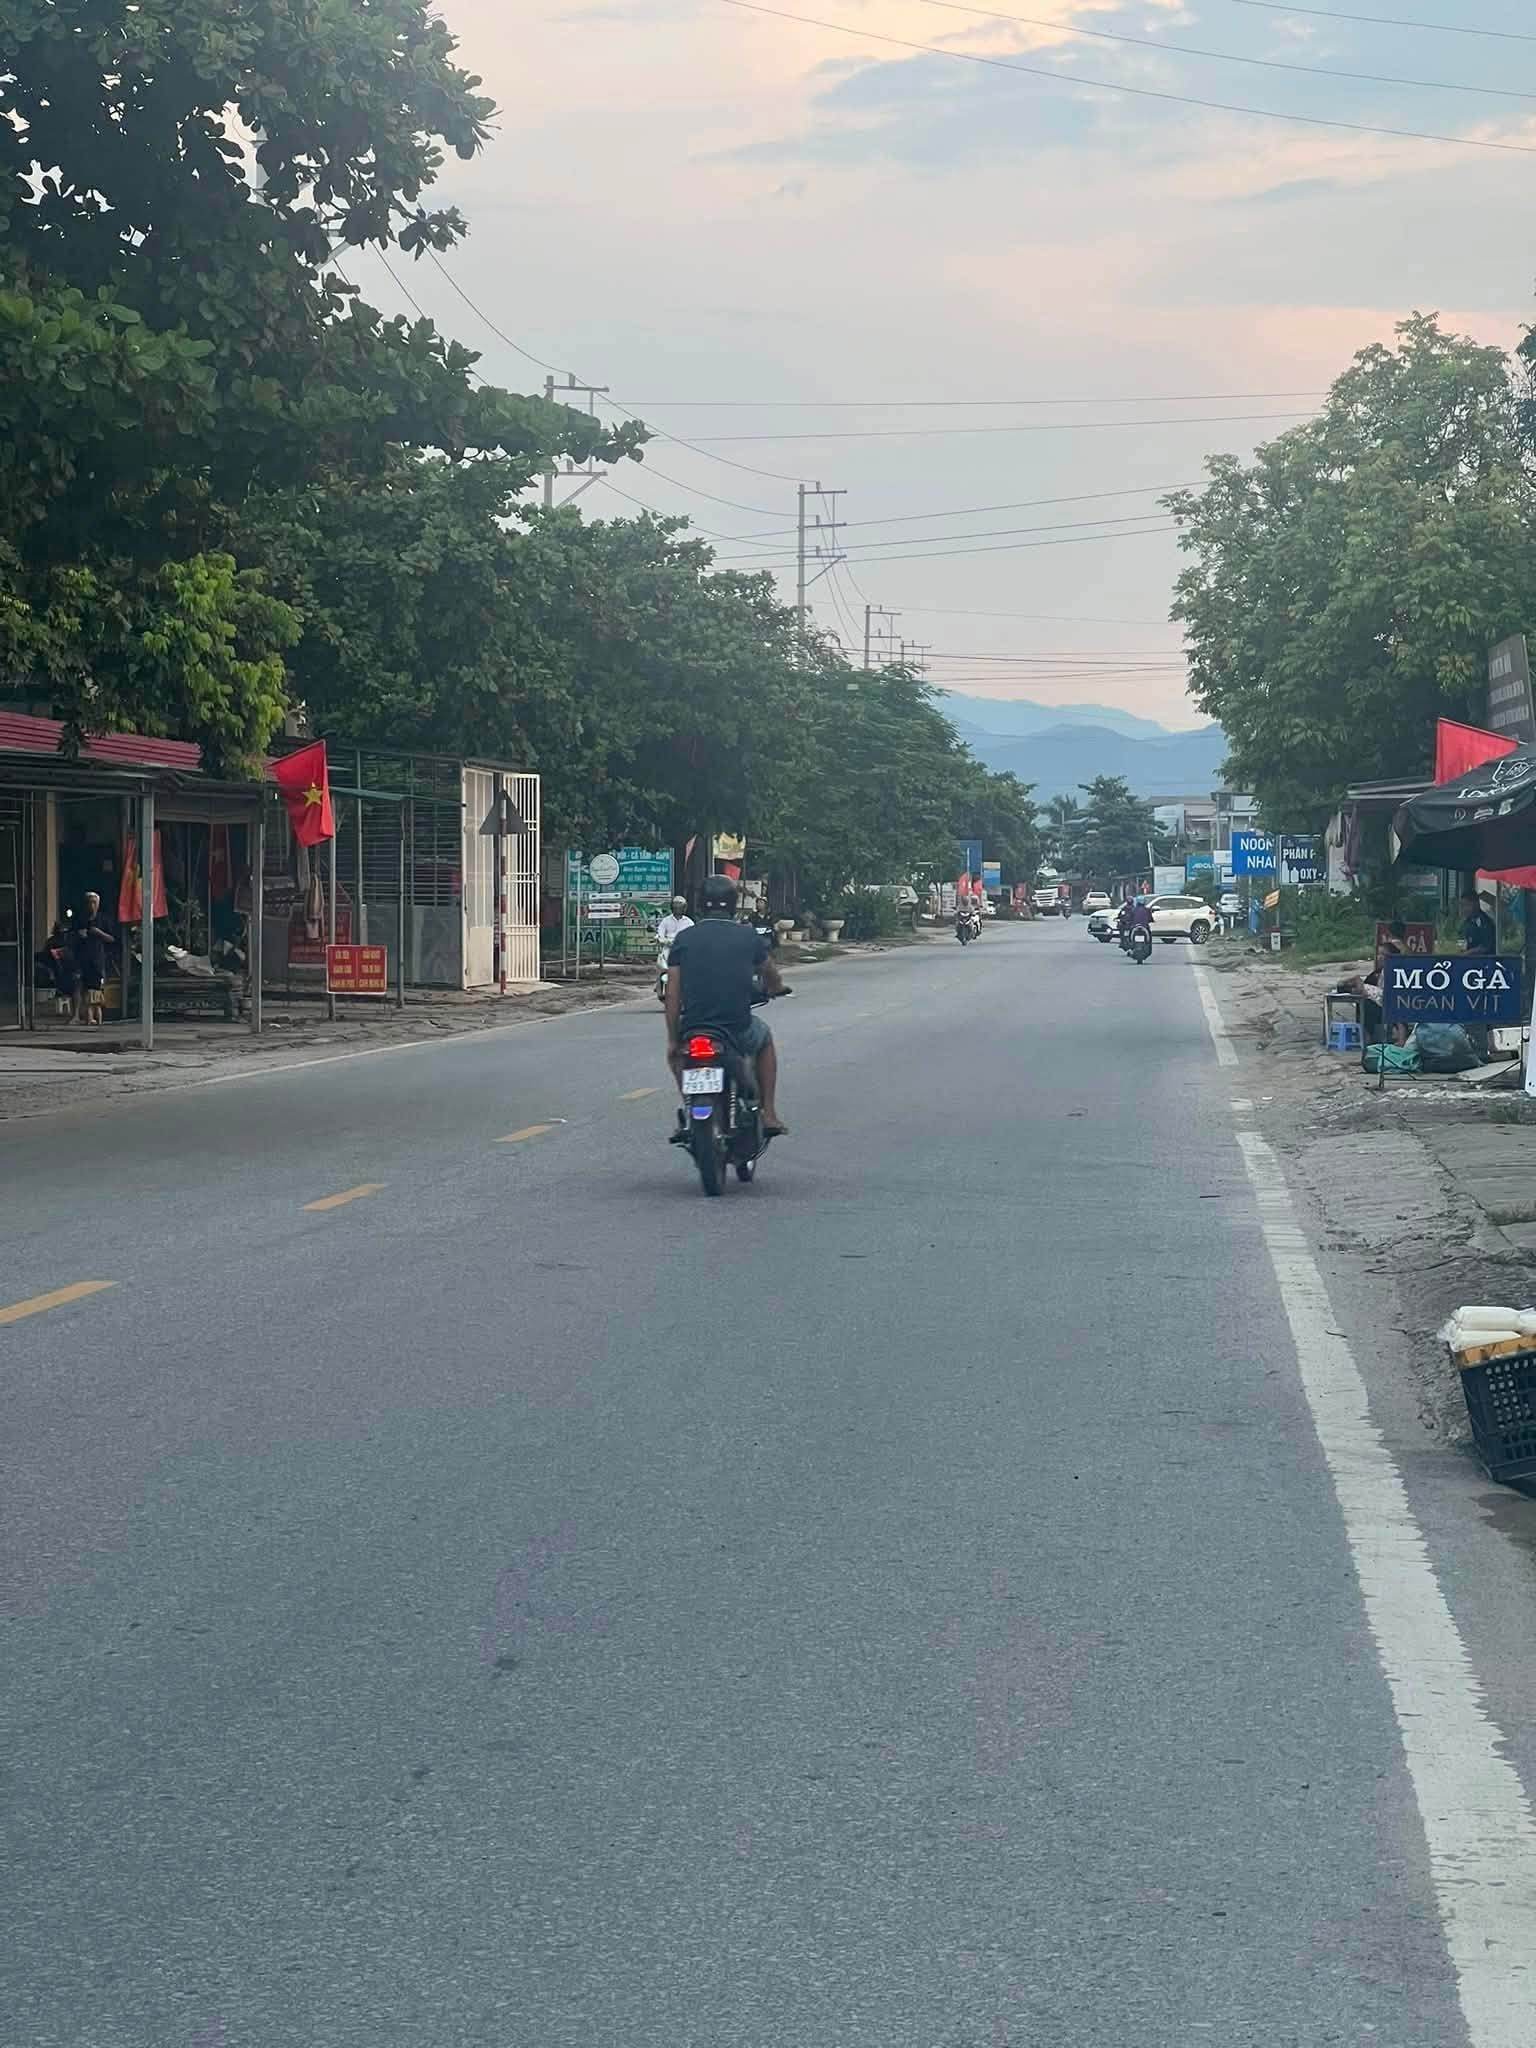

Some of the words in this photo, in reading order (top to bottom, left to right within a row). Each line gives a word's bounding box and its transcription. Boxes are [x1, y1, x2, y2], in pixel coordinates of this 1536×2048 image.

[1240, 838, 1275, 851] NOON
[1393, 960, 1451, 990] MỔ
[1462, 961, 1511, 990] GÀ
[1396, 995, 1455, 1011] NGAN
[1466, 995, 1503, 1014] VỊT
